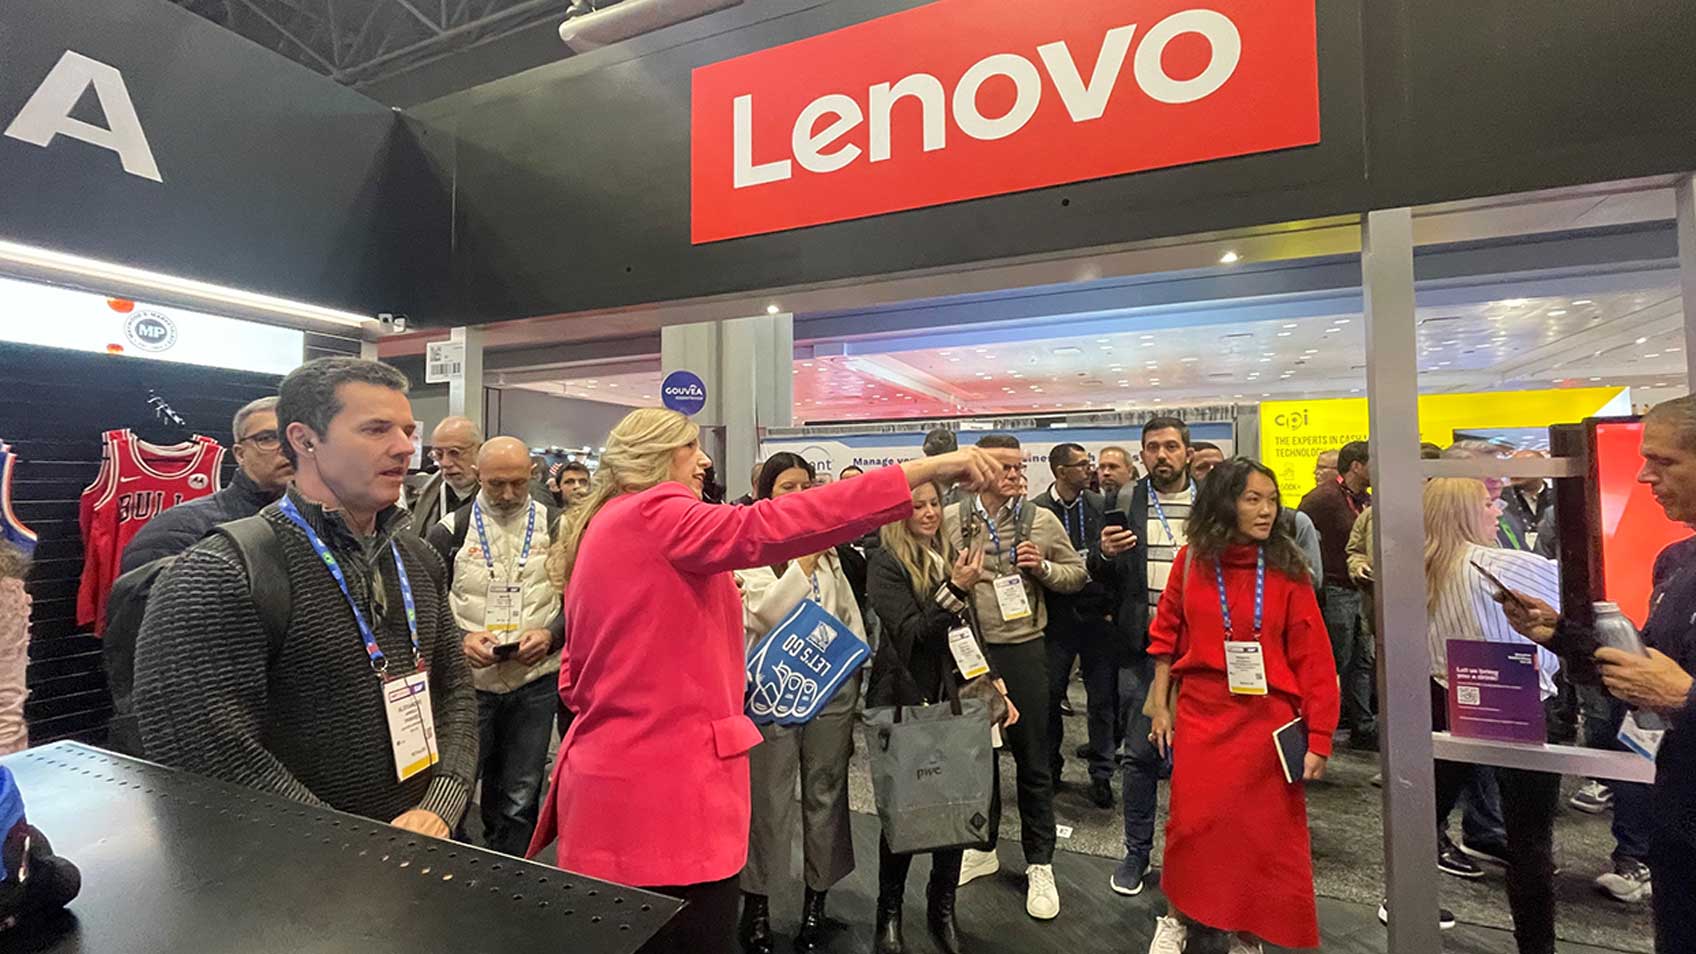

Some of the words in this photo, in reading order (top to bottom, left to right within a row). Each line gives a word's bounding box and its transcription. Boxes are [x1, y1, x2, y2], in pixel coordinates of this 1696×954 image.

[733, 9, 1242, 189] Lenovo
[3, 50, 164, 183] A
[138, 323, 165, 339] MP
[1275, 436, 1289, 446] THE
[1292, 434, 1327, 446] EXPERTS
[1329, 434, 1338, 445] IN
[853, 458, 894, 467] Manage
[782, 633, 805, 657] GO
[916, 766, 942, 781] pwc
